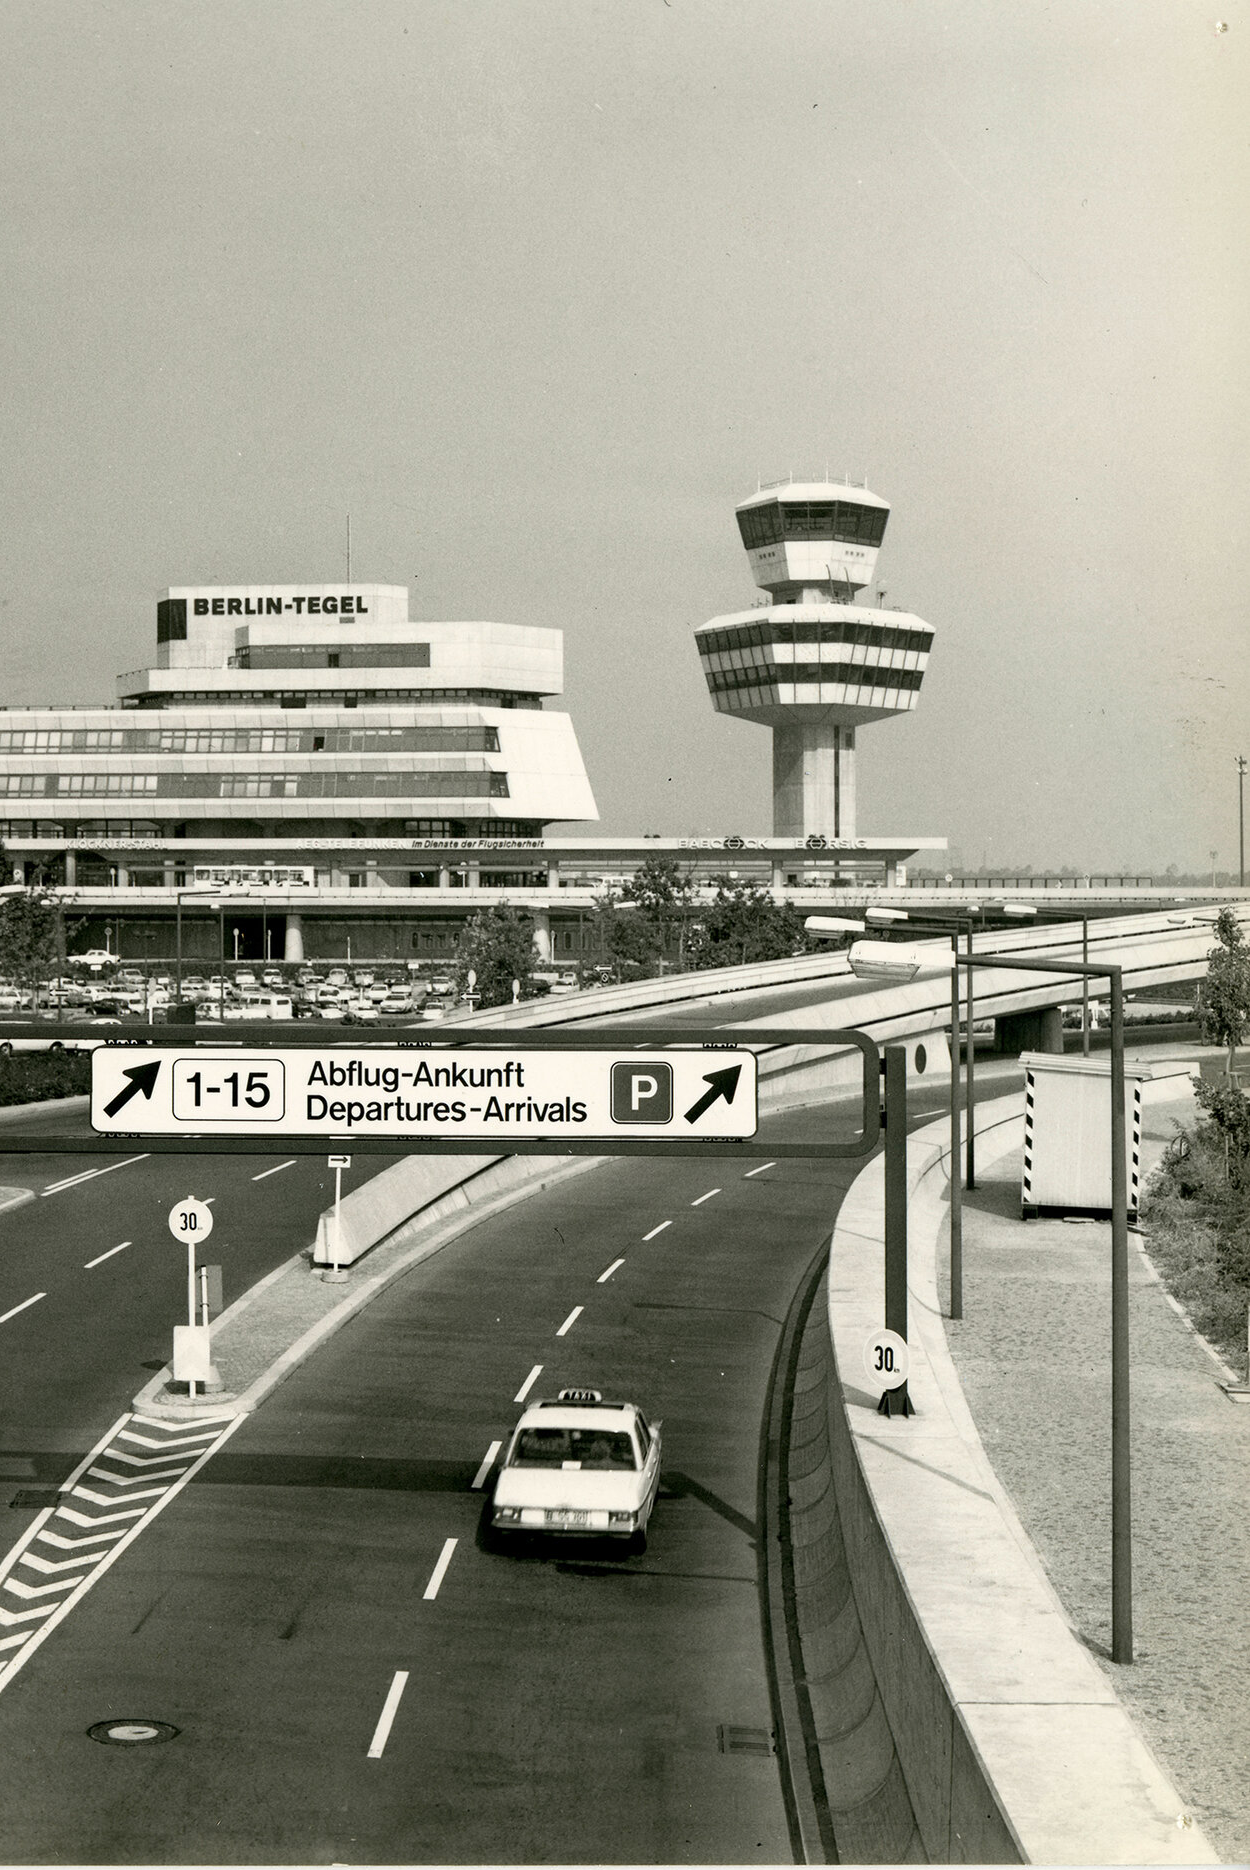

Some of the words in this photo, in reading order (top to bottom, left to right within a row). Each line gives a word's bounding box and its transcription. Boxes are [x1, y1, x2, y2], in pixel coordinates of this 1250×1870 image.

[194, 596, 368, 615] BERLIN-TEGEL
[424, 840, 458, 848] Dienste
[461, 840, 476, 848] der
[478, 840, 544, 849] Flugsicherheit
[187, 1072, 270, 1108] 1-15
[308, 1061, 524, 1092] Abflug-Ankunft
[632, 1076, 658, 1110] P
[307, 1095, 587, 1126] Departures-Arrivals
[180, 1213, 197, 1230] 30
[875, 1345, 894, 1372] 30
